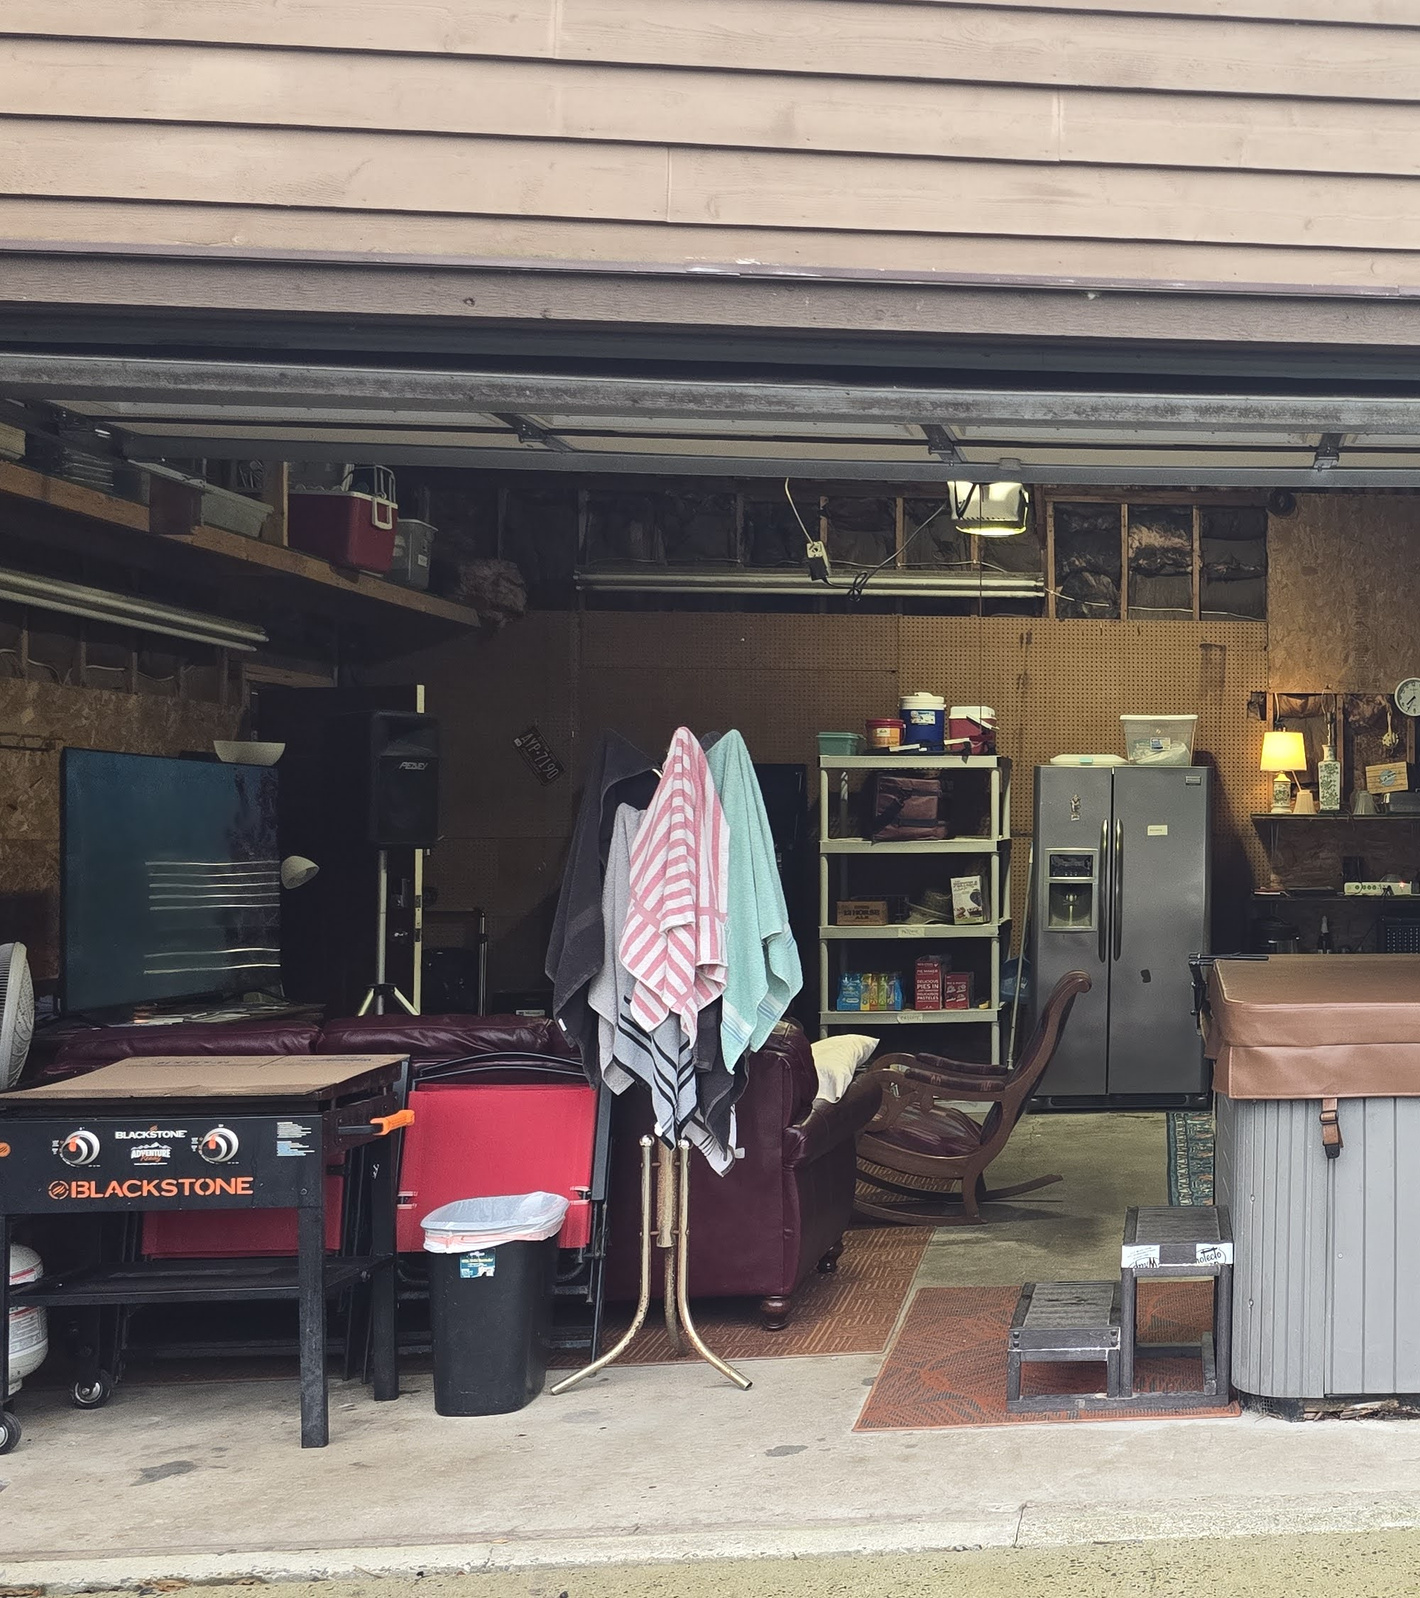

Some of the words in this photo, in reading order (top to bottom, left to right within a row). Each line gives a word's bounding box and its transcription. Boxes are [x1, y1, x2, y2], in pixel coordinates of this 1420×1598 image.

[114, 1130, 188, 1140] BLACKSTONE
[130, 1149, 171, 1159] ADVENTURE
[70, 1176, 254, 1199] BLACKSTONE
